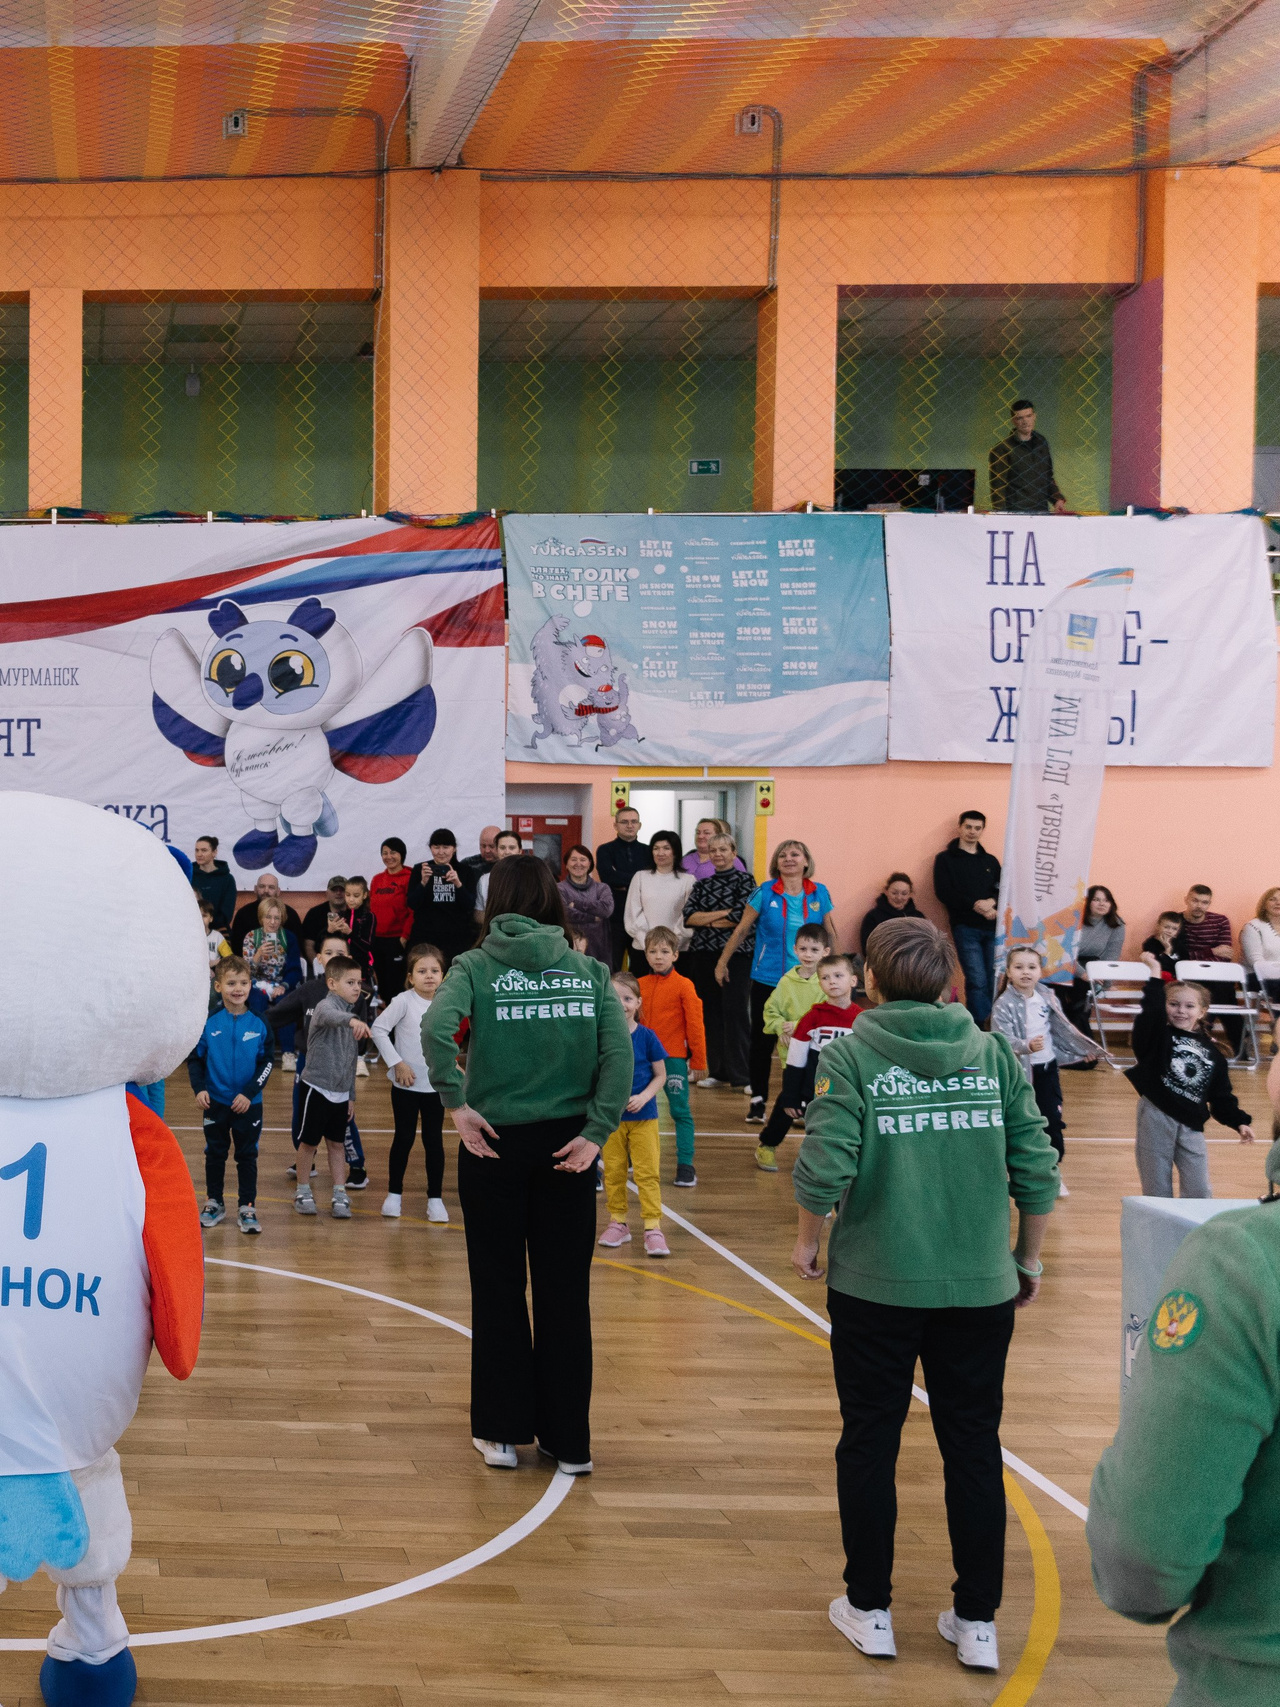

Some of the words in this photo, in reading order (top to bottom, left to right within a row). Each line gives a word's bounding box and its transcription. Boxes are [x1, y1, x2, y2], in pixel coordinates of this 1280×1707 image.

[640, 541, 659, 549] LET
[662, 541, 672, 549] IT
[778, 540, 800, 549] LET
[803, 540, 815, 548] IT
[530, 543, 628, 557] YUKIGASSEN
[640, 549, 673, 557] SNOW
[779, 549, 815, 557] SNOW
[986, 531, 1045, 586] НА
[570, 568, 628, 583] ТОЛК
[685, 575, 720, 583] SNOW
[732, 571, 753, 579] LET
[756, 570, 768, 578] IT
[733, 579, 768, 587] SNOW
[532, 581, 546, 598] В
[550, 584, 629, 602] СНЕГЕ
[782, 618, 803, 626] LET
[806, 618, 818, 626] IT
[737, 627, 771, 635] SNOW
[783, 627, 818, 635] SNOW
[642, 660, 663, 669] LET
[666, 661, 678, 669] IT
[643, 670, 677, 678] SNOW
[491, 976, 593, 992] YUKIGASSEN
[496, 1002, 595, 1021] REFEREE
[818, 1029, 846, 1045] FI
[866, 1075, 1000, 1097] YUKIGASSEN
[877, 1108, 1004, 1134] REFEREE
